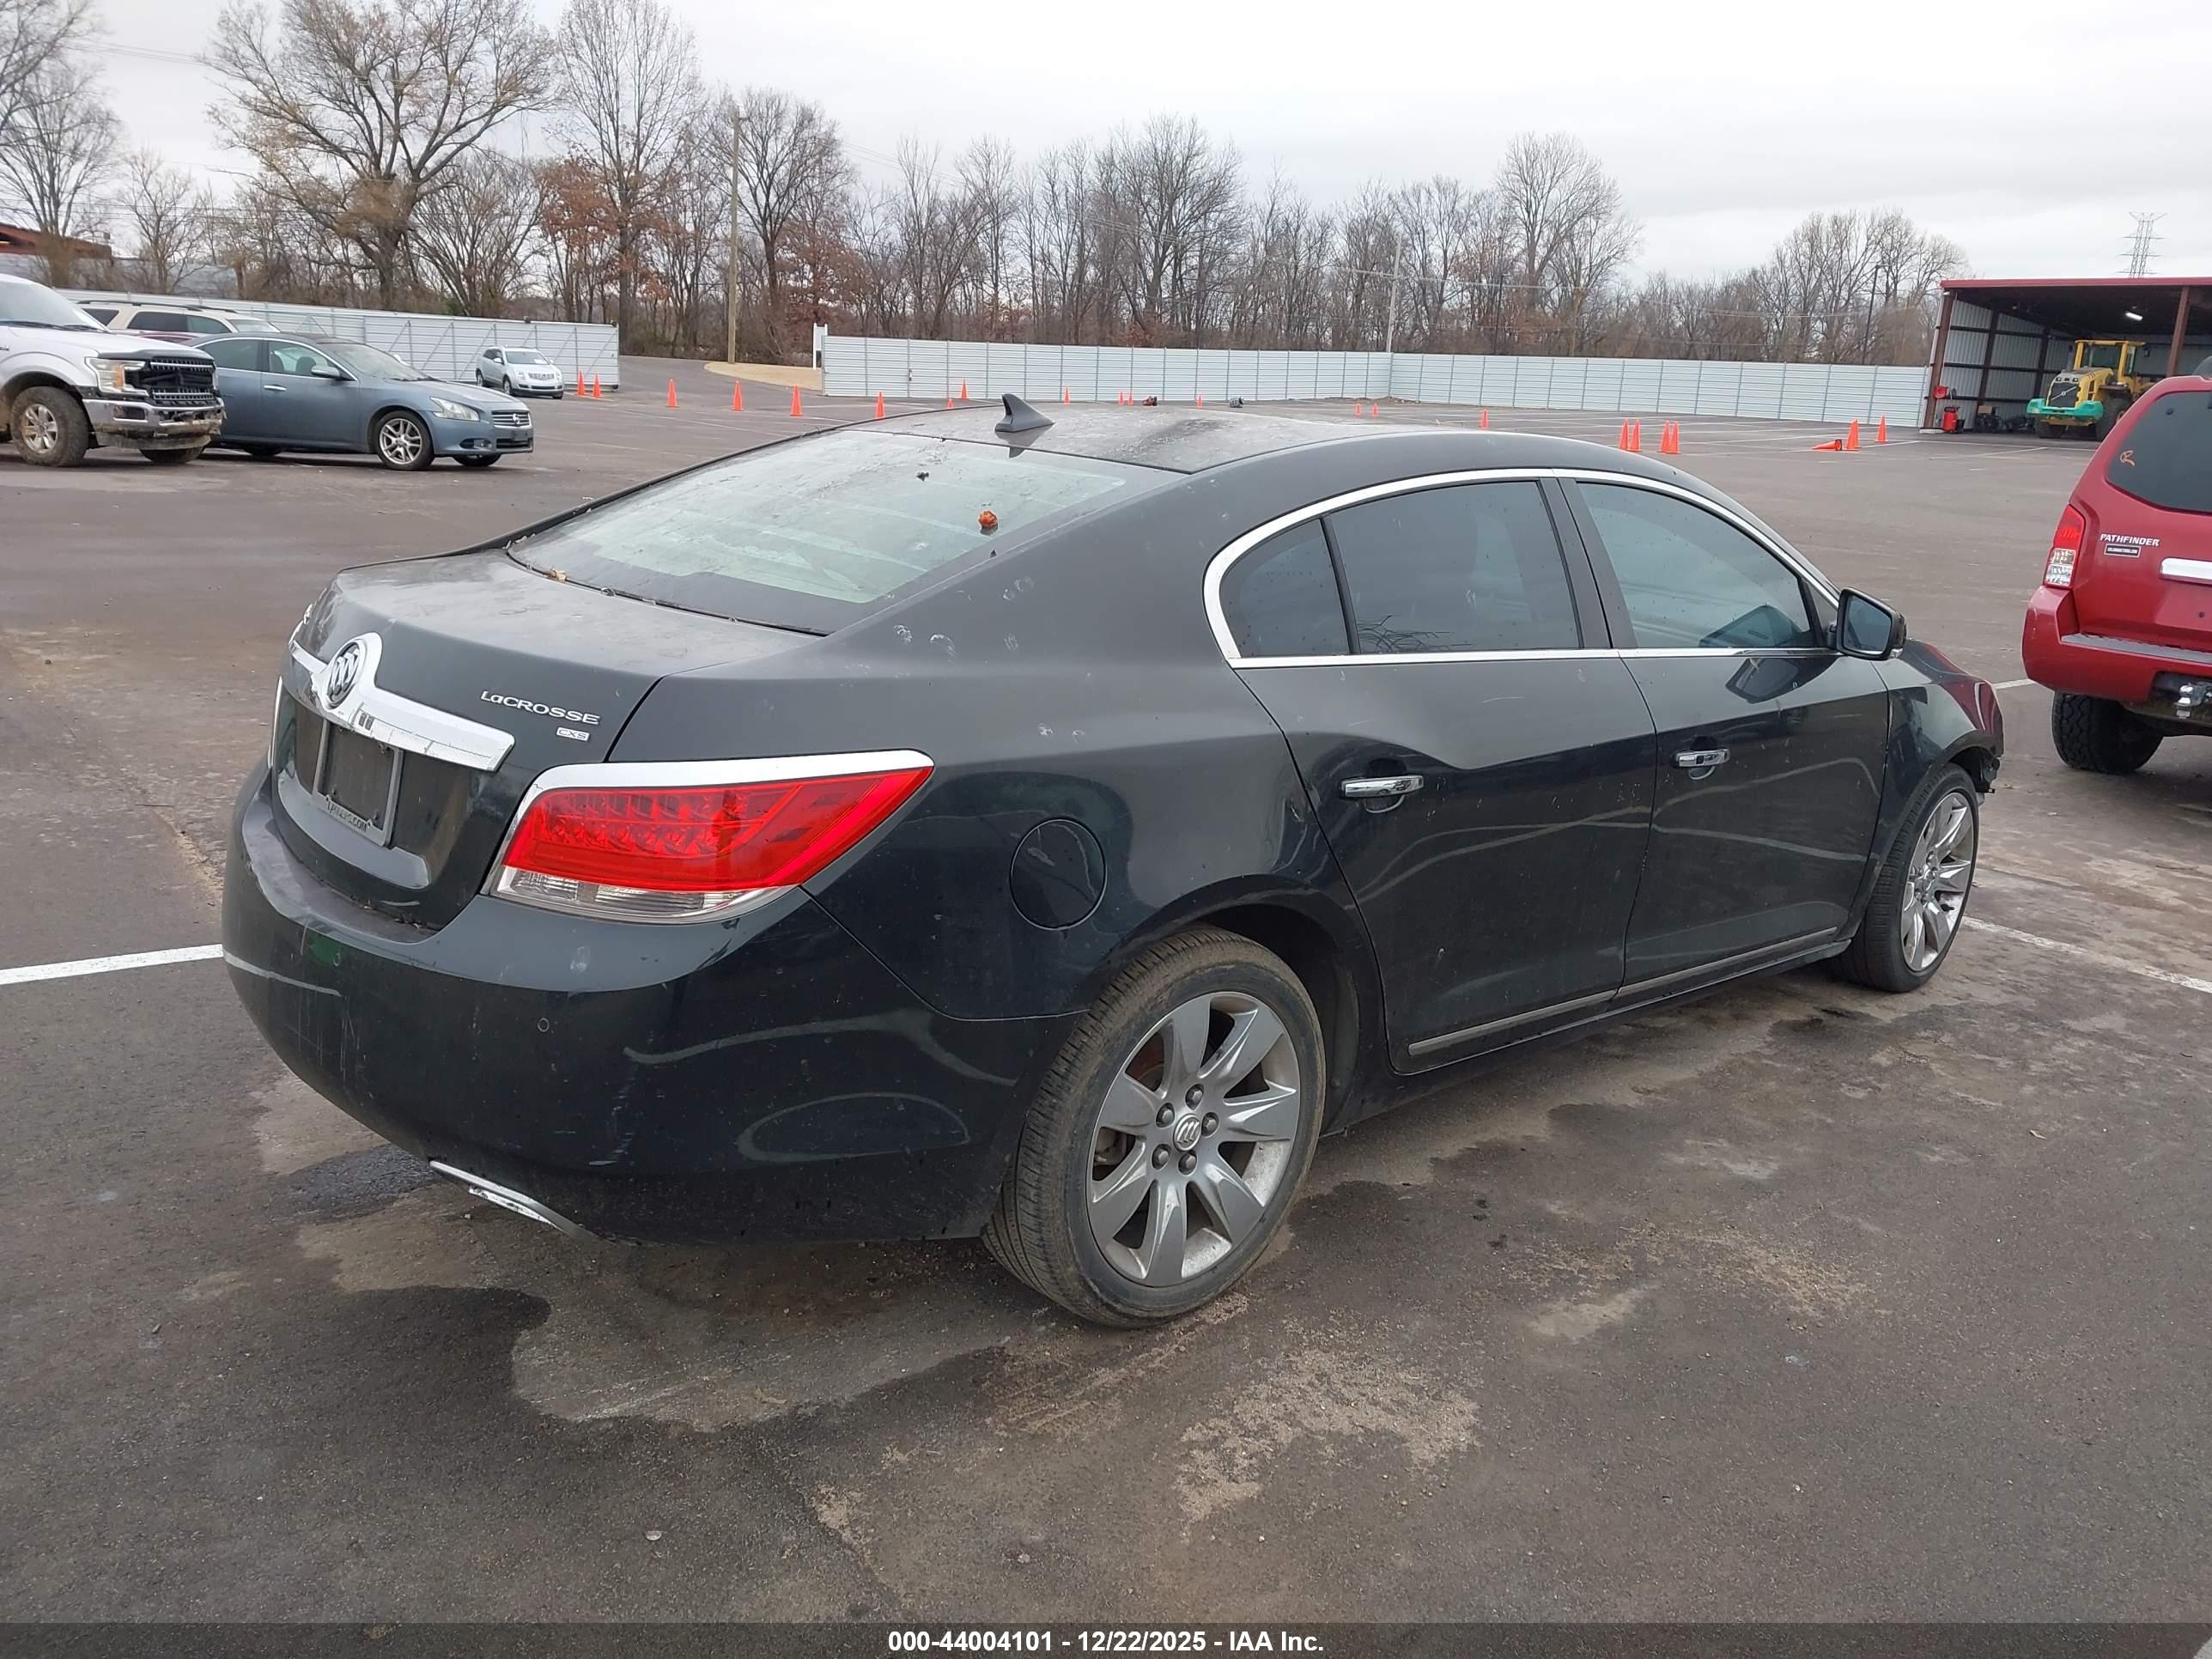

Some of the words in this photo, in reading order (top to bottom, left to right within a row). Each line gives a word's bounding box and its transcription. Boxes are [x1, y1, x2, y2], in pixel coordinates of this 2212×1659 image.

[2100, 533, 2160, 547] PATHFINDER
[480, 690, 601, 726] LaCROSSE
[558, 728, 587, 740] CXS
